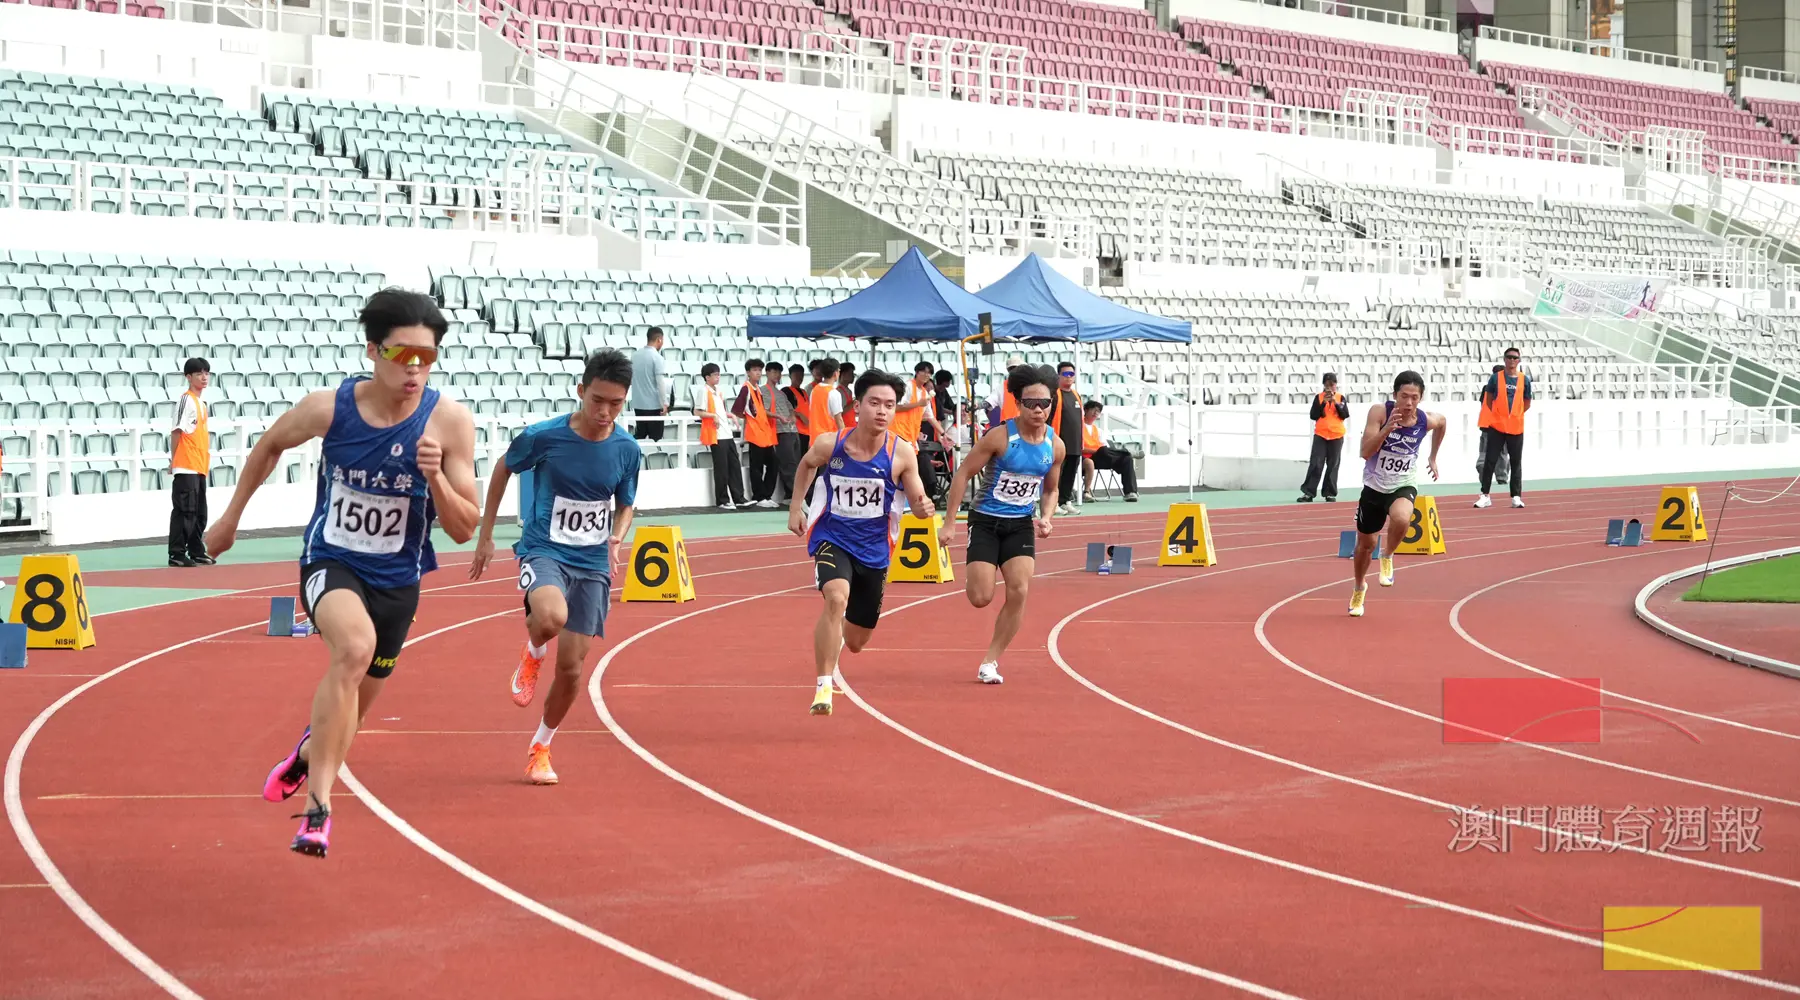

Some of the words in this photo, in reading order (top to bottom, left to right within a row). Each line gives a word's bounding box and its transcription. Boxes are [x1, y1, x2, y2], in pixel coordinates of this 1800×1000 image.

[1380, 456, 1411, 473] 1394
[834, 485, 881, 508] 1134
[1000, 479, 1038, 498] 1381
[333, 497, 403, 537] 1502
[556, 508, 606, 533] 1033
[1429, 507, 1440, 543] 3
[1661, 496, 1685, 530] 2
[899, 528, 931, 569] 5
[1169, 516, 1199, 554] 4
[634, 541, 670, 588] 6
[676, 541, 689, 587] 6
[21, 574, 66, 632] 8
[73, 573, 88, 630] 8
[55, 638, 76, 646] NISHI
